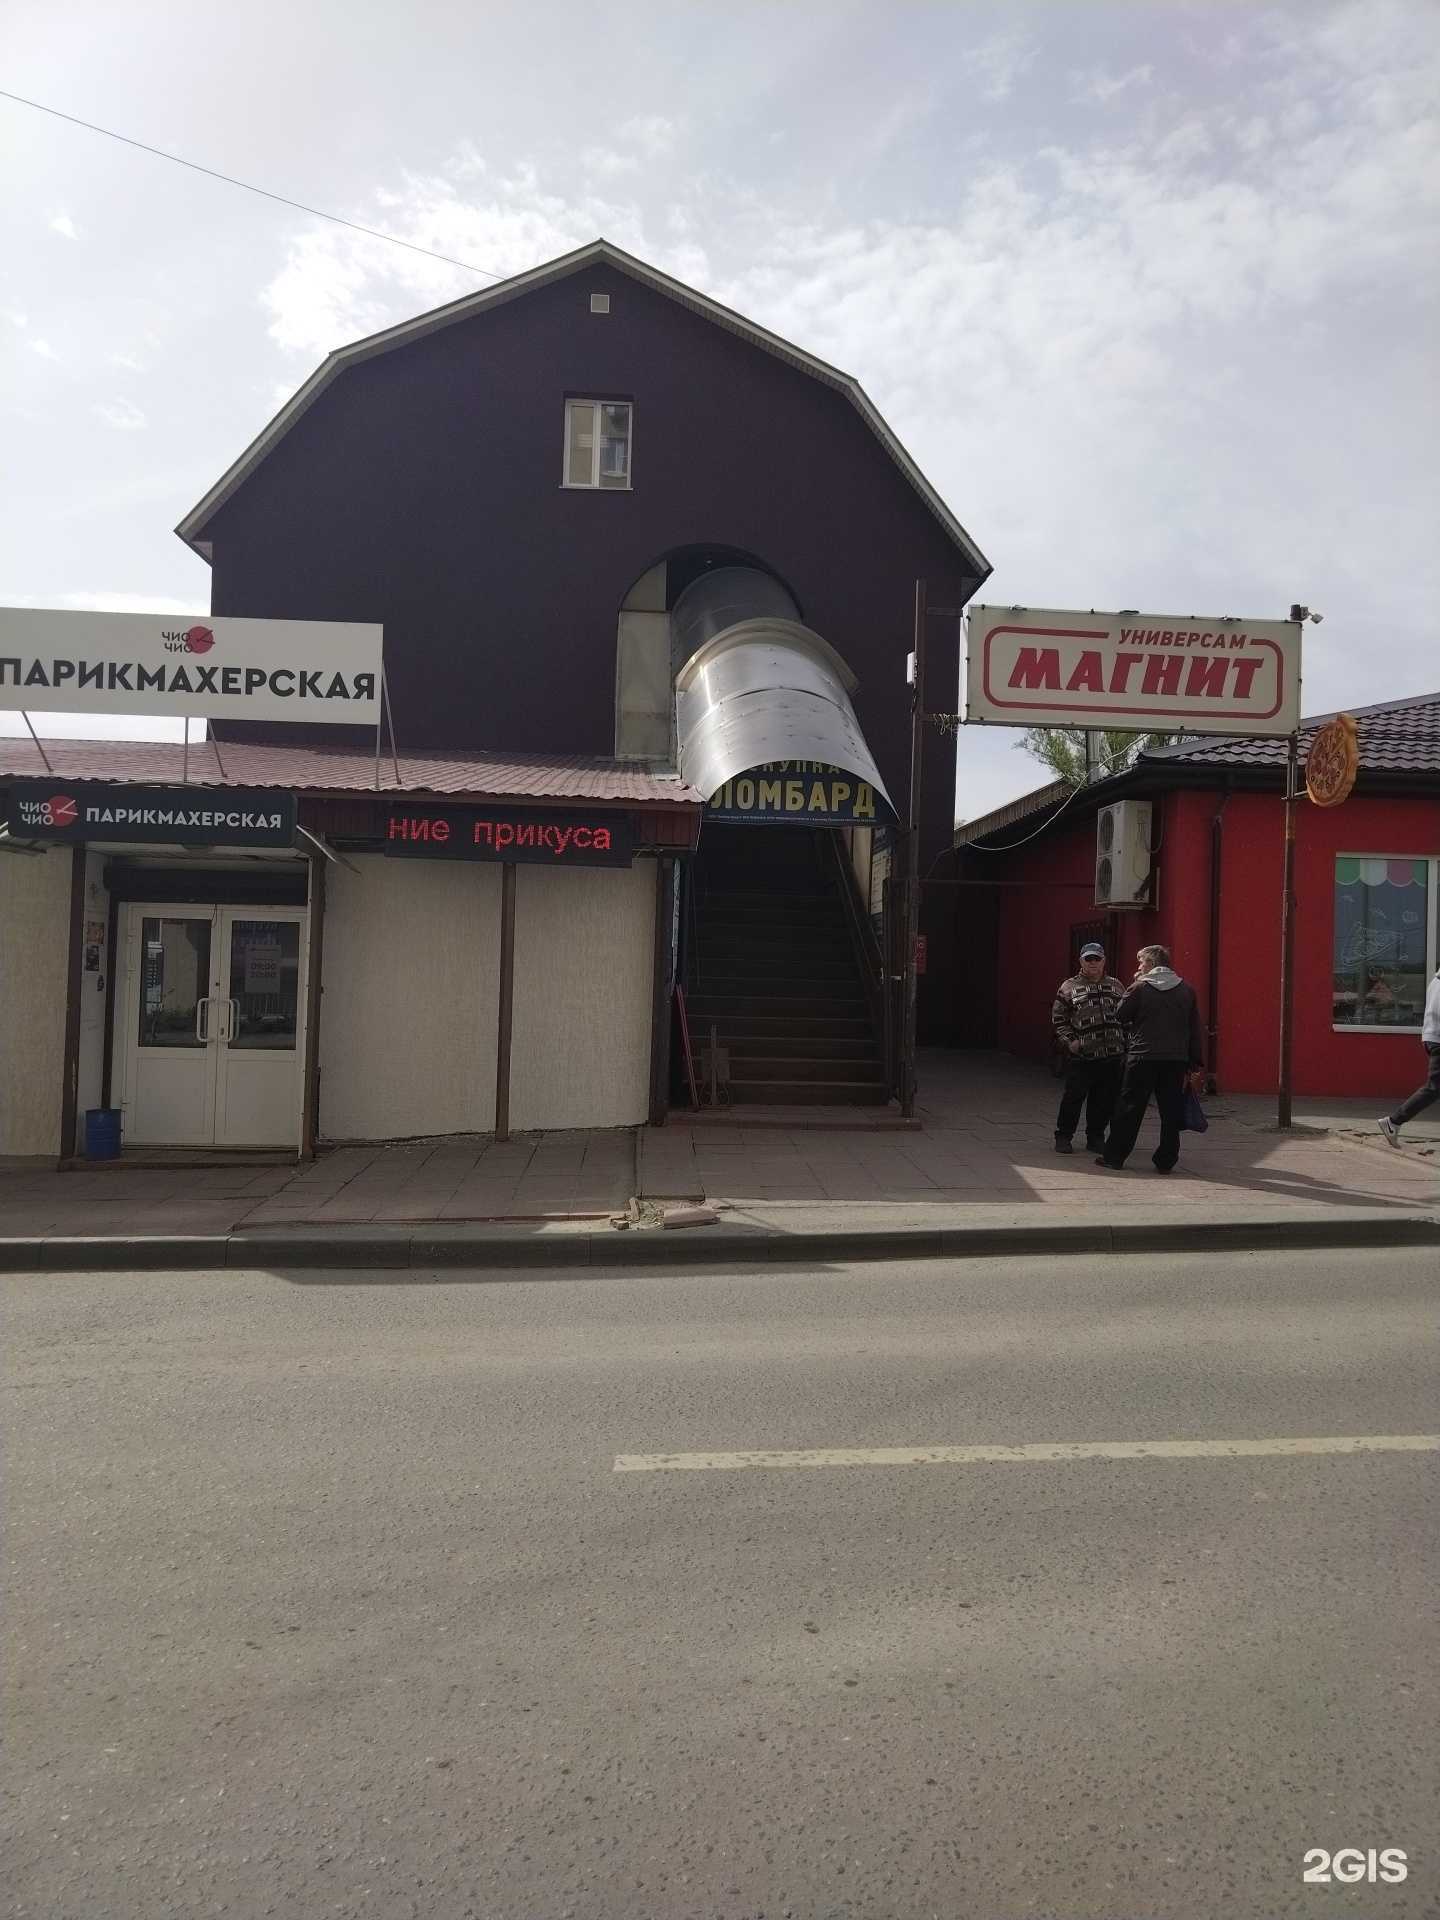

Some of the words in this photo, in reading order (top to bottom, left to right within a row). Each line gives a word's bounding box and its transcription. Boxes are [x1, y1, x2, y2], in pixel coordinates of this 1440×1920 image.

[161, 631, 191, 641] ЧИО
[1118, 628, 1248, 650] УНИВЕРСАМ
[164, 643, 193, 653] ЧИО
[0, 657, 376, 700] ПАРИКМАХЕРСКАЯ
[1007, 647, 1265, 699] МАГНИТ
[19, 802, 52, 813] ЧИО
[710, 779, 876, 818] ЛОМБАРД
[22, 814, 55, 825] ЧИО
[86, 807, 282, 828] ПАРИКМАХЕРСКАЯ
[388, 817, 450, 841] ние
[473, 822, 612, 854] прикуса
